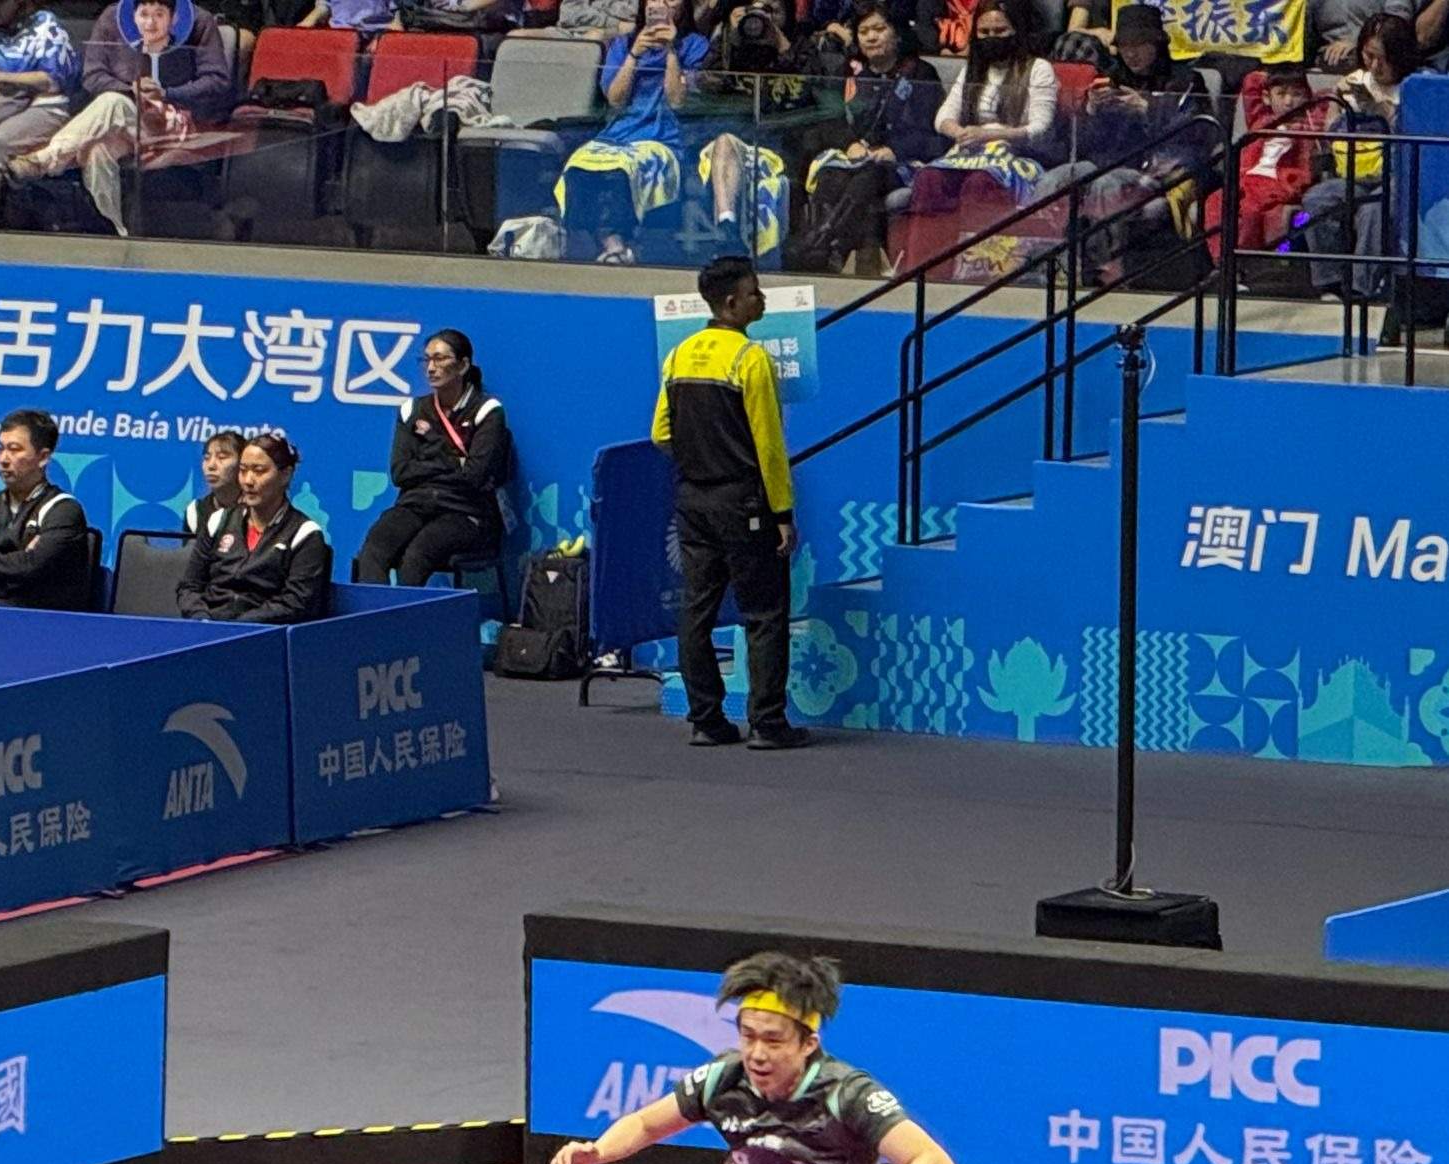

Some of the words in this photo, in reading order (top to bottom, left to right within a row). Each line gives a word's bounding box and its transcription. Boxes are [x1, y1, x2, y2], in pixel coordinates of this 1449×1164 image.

[113, 411, 170, 440] Baía
[1180, 506, 1319, 575] 澳门
[358, 656, 422, 719] PICC
[318, 722, 467, 786] 中国人民保险
[163, 762, 215, 821] ANTA
[1158, 1027, 1321, 1107] PICC
